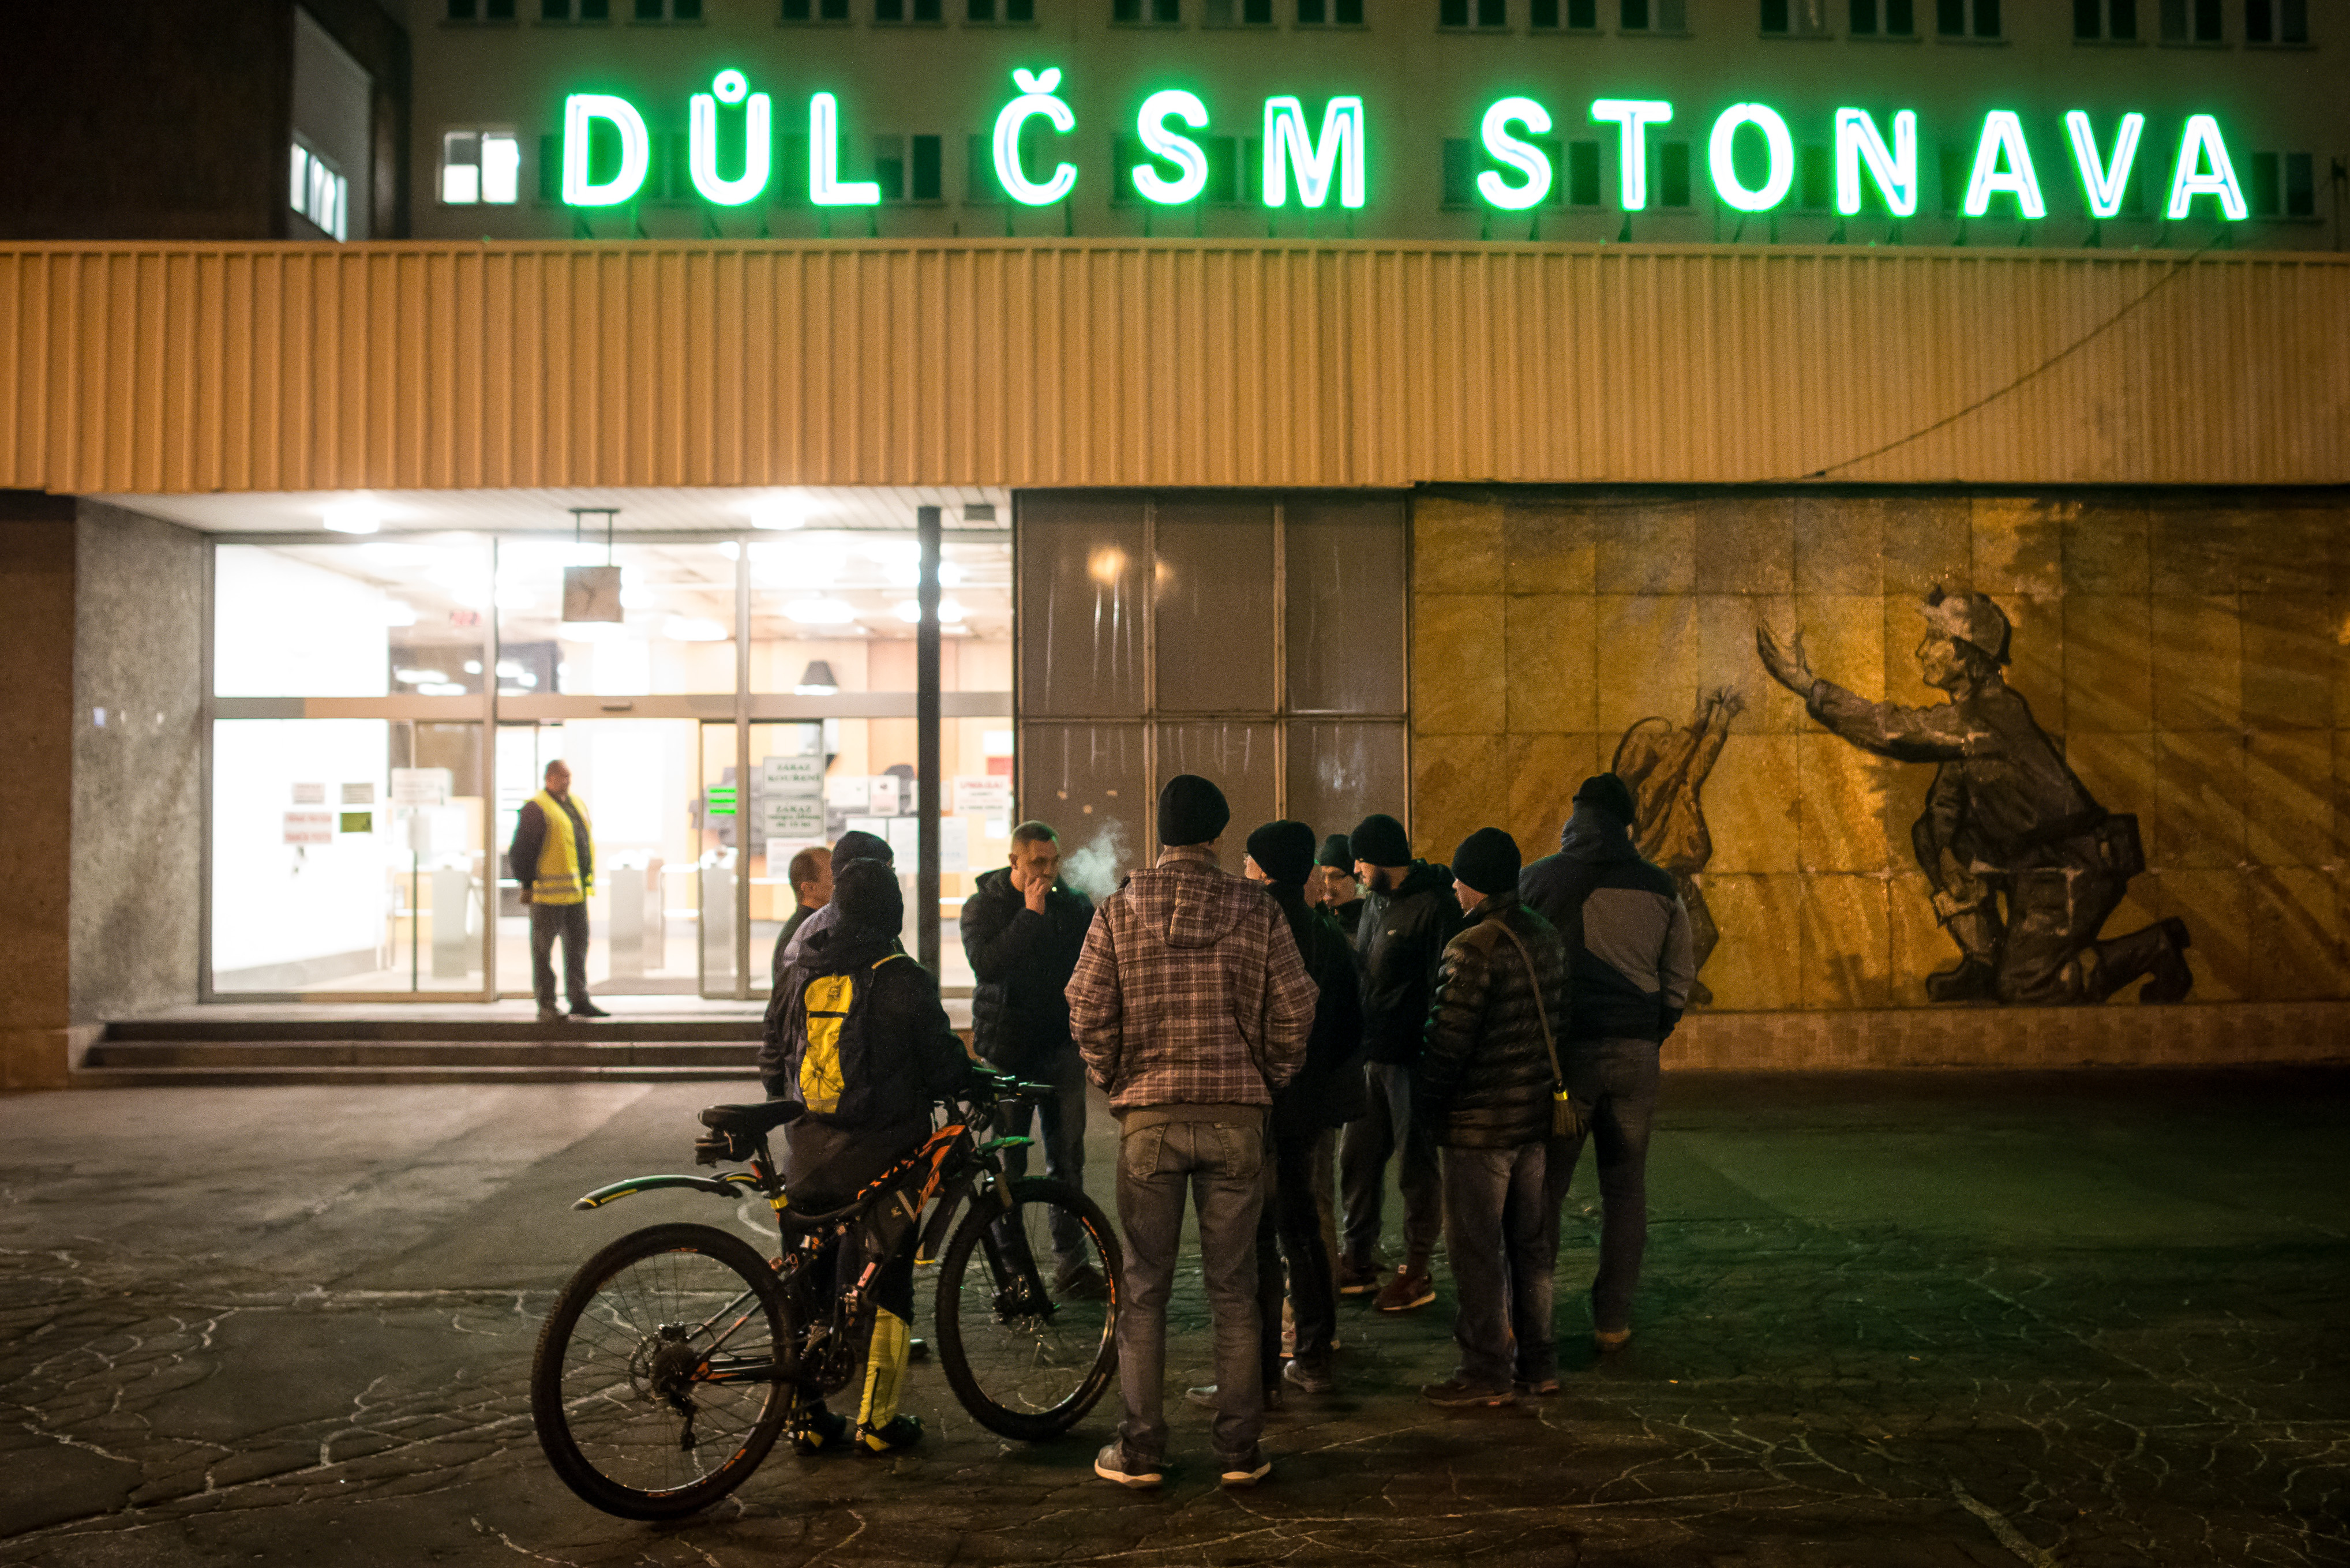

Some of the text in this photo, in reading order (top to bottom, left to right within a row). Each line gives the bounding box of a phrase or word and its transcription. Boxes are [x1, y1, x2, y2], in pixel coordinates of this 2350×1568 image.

[561, 66, 2249, 222] DŮL ČSM STONAVA
